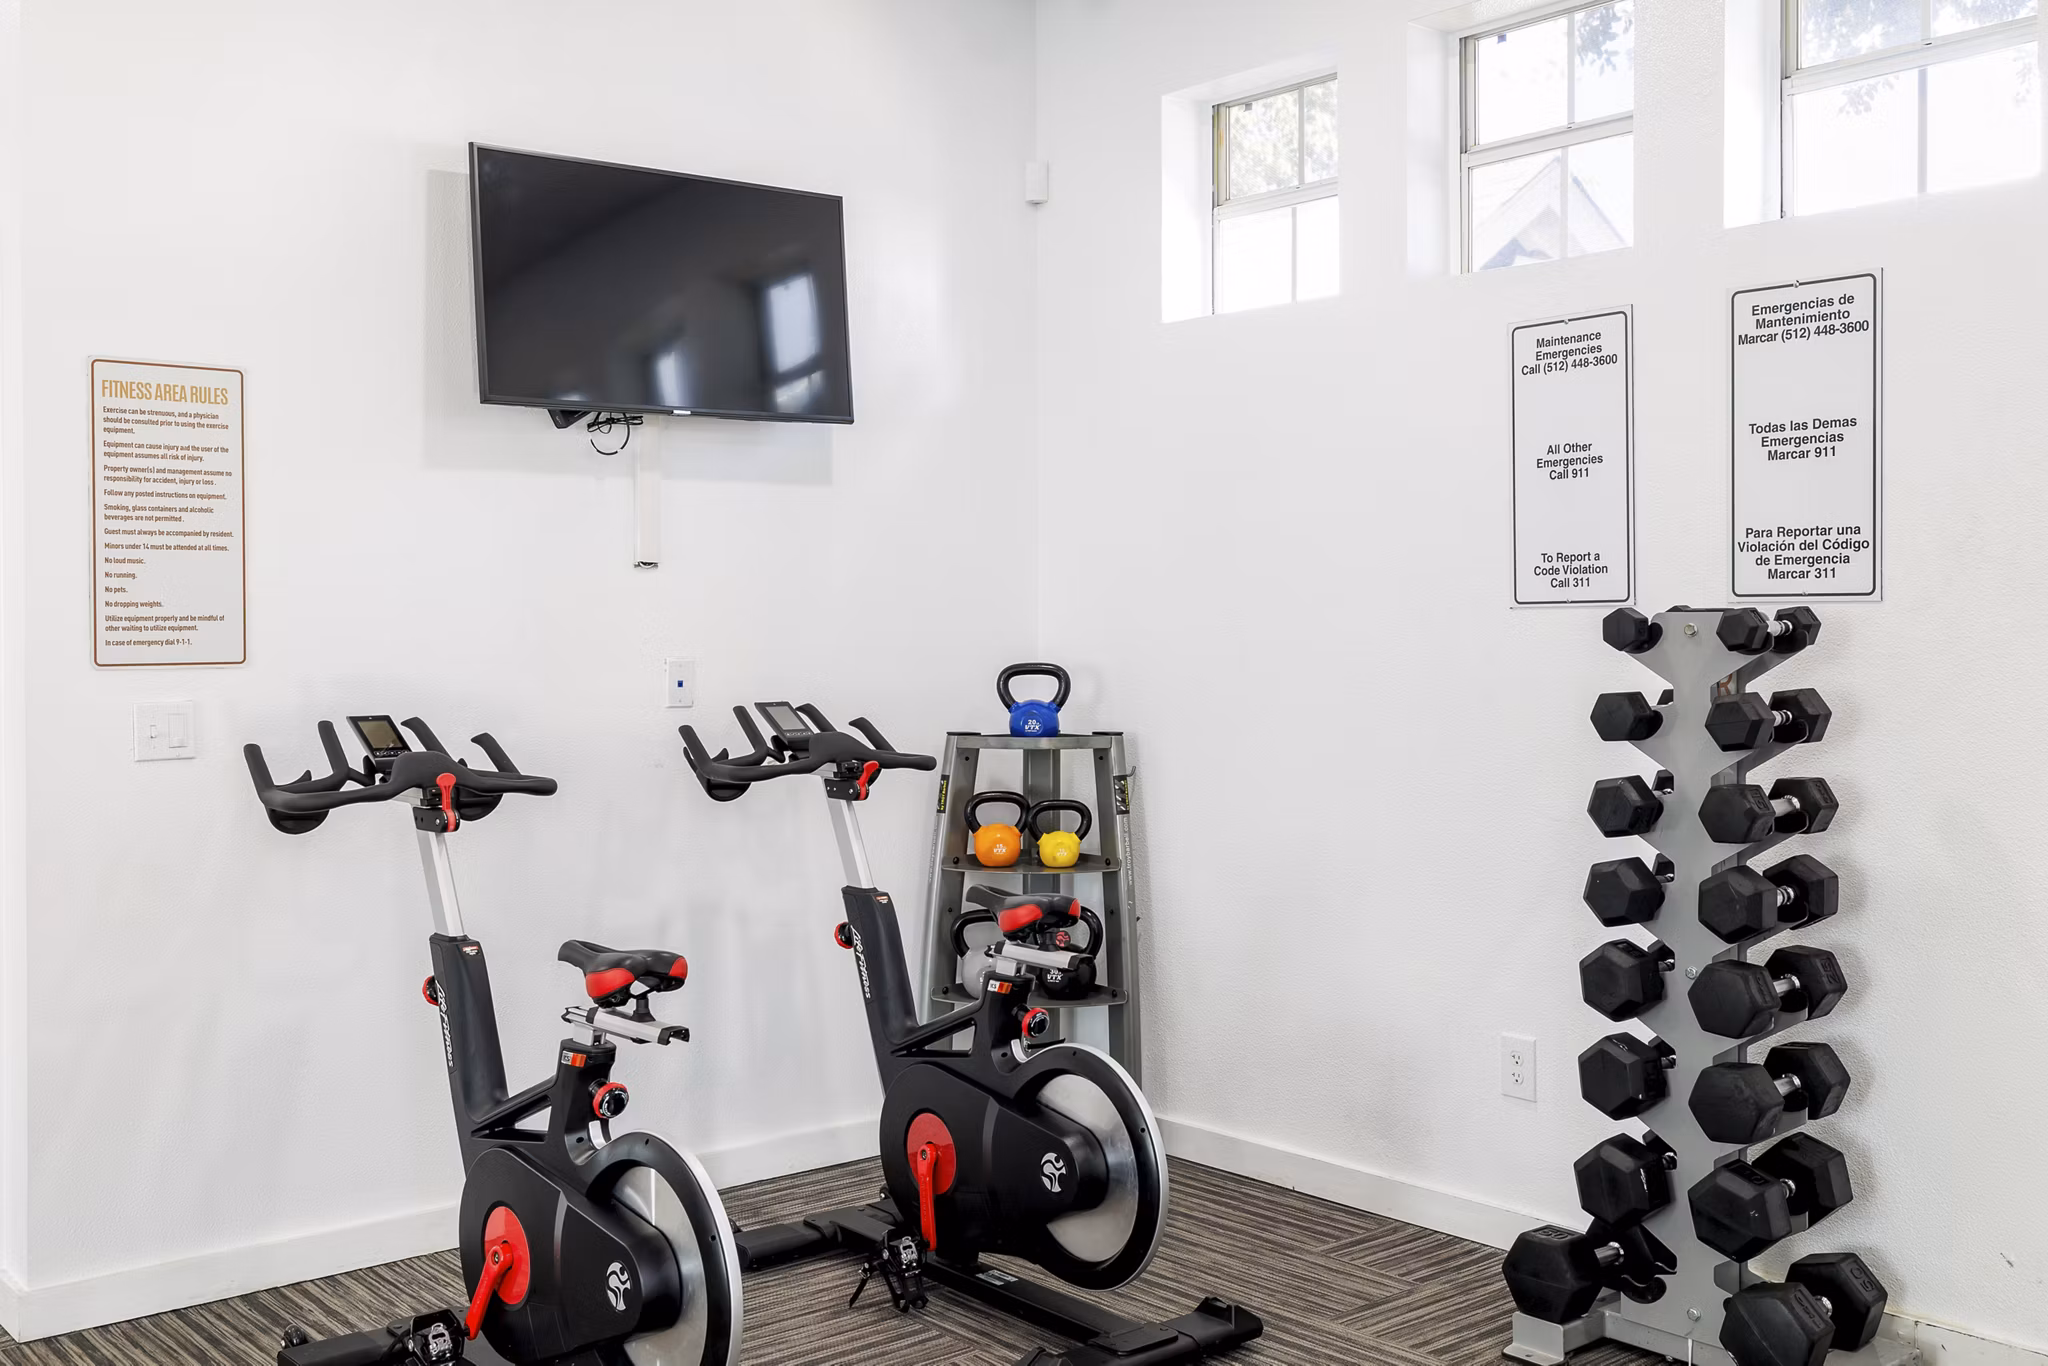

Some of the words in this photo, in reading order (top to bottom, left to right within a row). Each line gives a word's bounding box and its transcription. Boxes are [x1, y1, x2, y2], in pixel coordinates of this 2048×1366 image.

[1752, 297, 1835, 316] Emergencias
[1838, 293, 1855, 305] de
[1756, 309, 1850, 330] Mantenimiento
[1738, 332, 1779, 346] Marcar
[1781, 326, 1811, 344] (512)
[1814, 320, 1869, 337] 448-3600
[1536, 332, 1602, 349] Maintenance
[1536, 344, 1602, 361] Emergencies
[1521, 364, 1540, 376] Call
[1543, 359, 1568, 375] (512)
[1571, 354, 1618, 369] 448-3600
[102, 380, 152, 400] FITNESS
[154, 383, 188, 402] AREA
[190, 386, 228, 405] RULES
[103, 406, 127, 414] Exercise
[147, 410, 177, 418] strenuous,
[180, 421, 196, 429] using
[1748, 422, 1786, 434] Todas
[1790, 420, 1808, 431] las
[1813, 418, 1857, 430] Demas
[103, 440, 134, 449] Equipment
[163, 444, 180, 452] injury
[1761, 432, 1844, 448] Emergencias
[1547, 444, 1560, 455] All
[1563, 442, 1593, 454] Other
[1768, 449, 1811, 461] Marcar
[1814, 445, 1835, 458] 911
[187, 454, 204, 463] injury.
[1536, 454, 1603, 469] Emergencies
[104, 464, 129, 473] Property
[1549, 469, 1569, 480] Call
[1572, 467, 1589, 479] 911
[104, 476, 143, 484] responsibility
[179, 478, 195, 486] injury
[104, 504, 131, 512] Smoking,
[137, 529, 157, 537] always
[1746, 528, 1773, 539] Para
[1777, 525, 1833, 539] Reportar
[1837, 526, 1861, 536] una
[1738, 540, 1795, 552] Violación
[1799, 539, 1818, 551] del
[1822, 538, 1870, 552] Código
[1541, 553, 1554, 563] To
[1556, 552, 1591, 564] Report
[1594, 553, 1600, 561] a
[1755, 555, 1771, 566] de
[1775, 552, 1850, 568] Emergencia
[1534, 565, 1560, 576] Code
[1562, 564, 1608, 575] Violation
[1768, 568, 1811, 580] Marcar
[1814, 567, 1835, 579] 311
[1550, 578, 1570, 588] Call
[1573, 577, 1590, 588] 311
